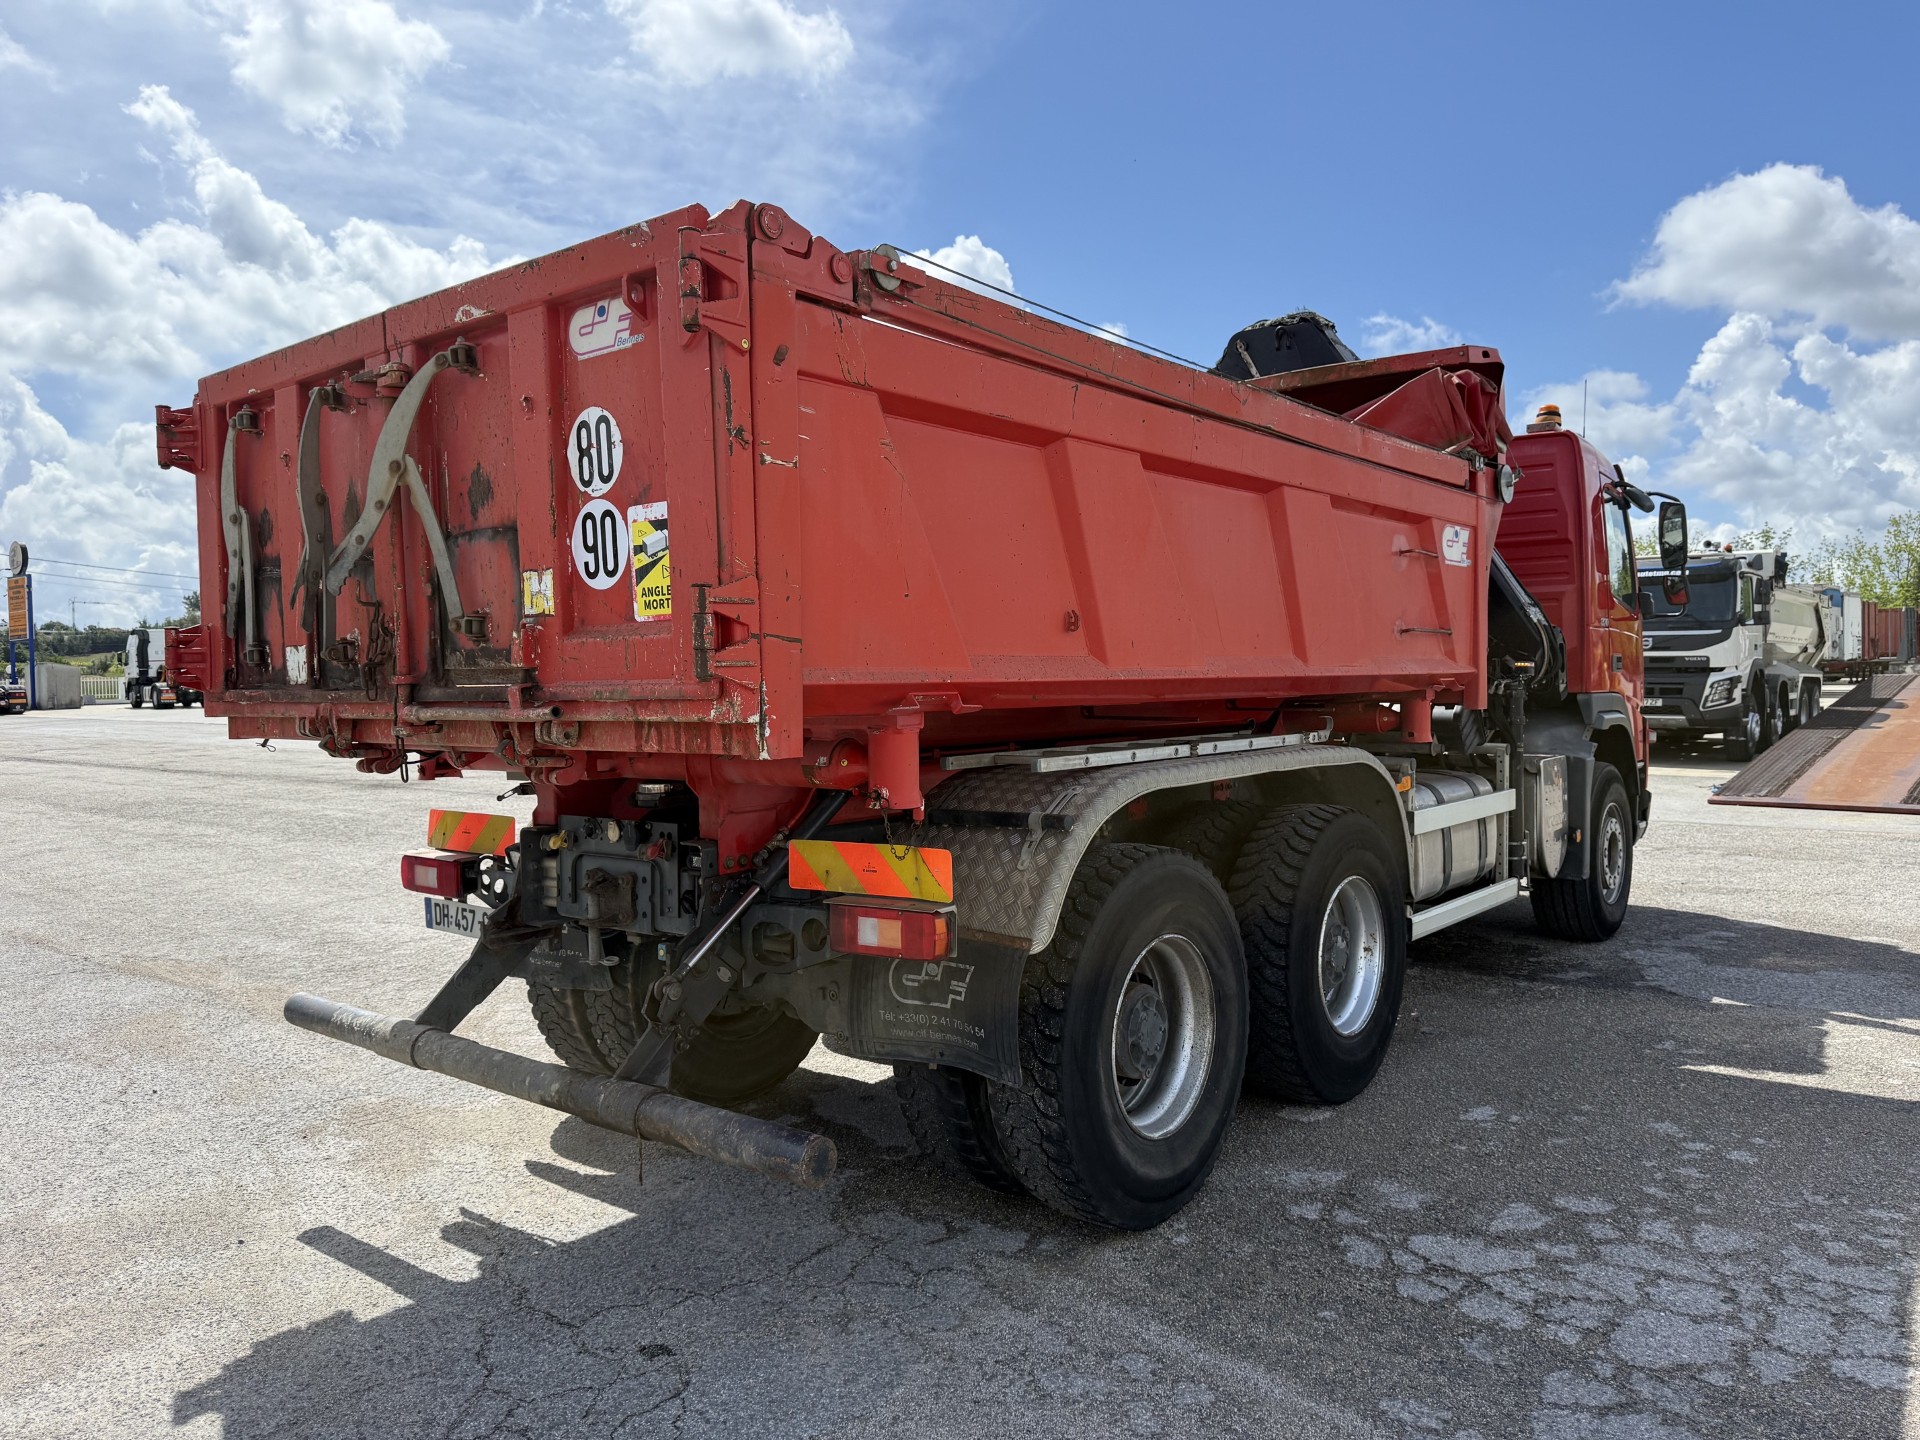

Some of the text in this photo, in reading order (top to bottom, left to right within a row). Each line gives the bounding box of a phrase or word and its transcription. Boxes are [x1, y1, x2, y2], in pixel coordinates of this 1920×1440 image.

[616, 333, 645, 348] Bennes
[576, 414, 614, 489] 80
[581, 509, 619, 580] 90
[641, 585, 672, 598] ANGLE
[644, 597, 671, 611] MORT
[931, 1015, 938, 1025] 2
[954, 1019, 963, 1031] 70
